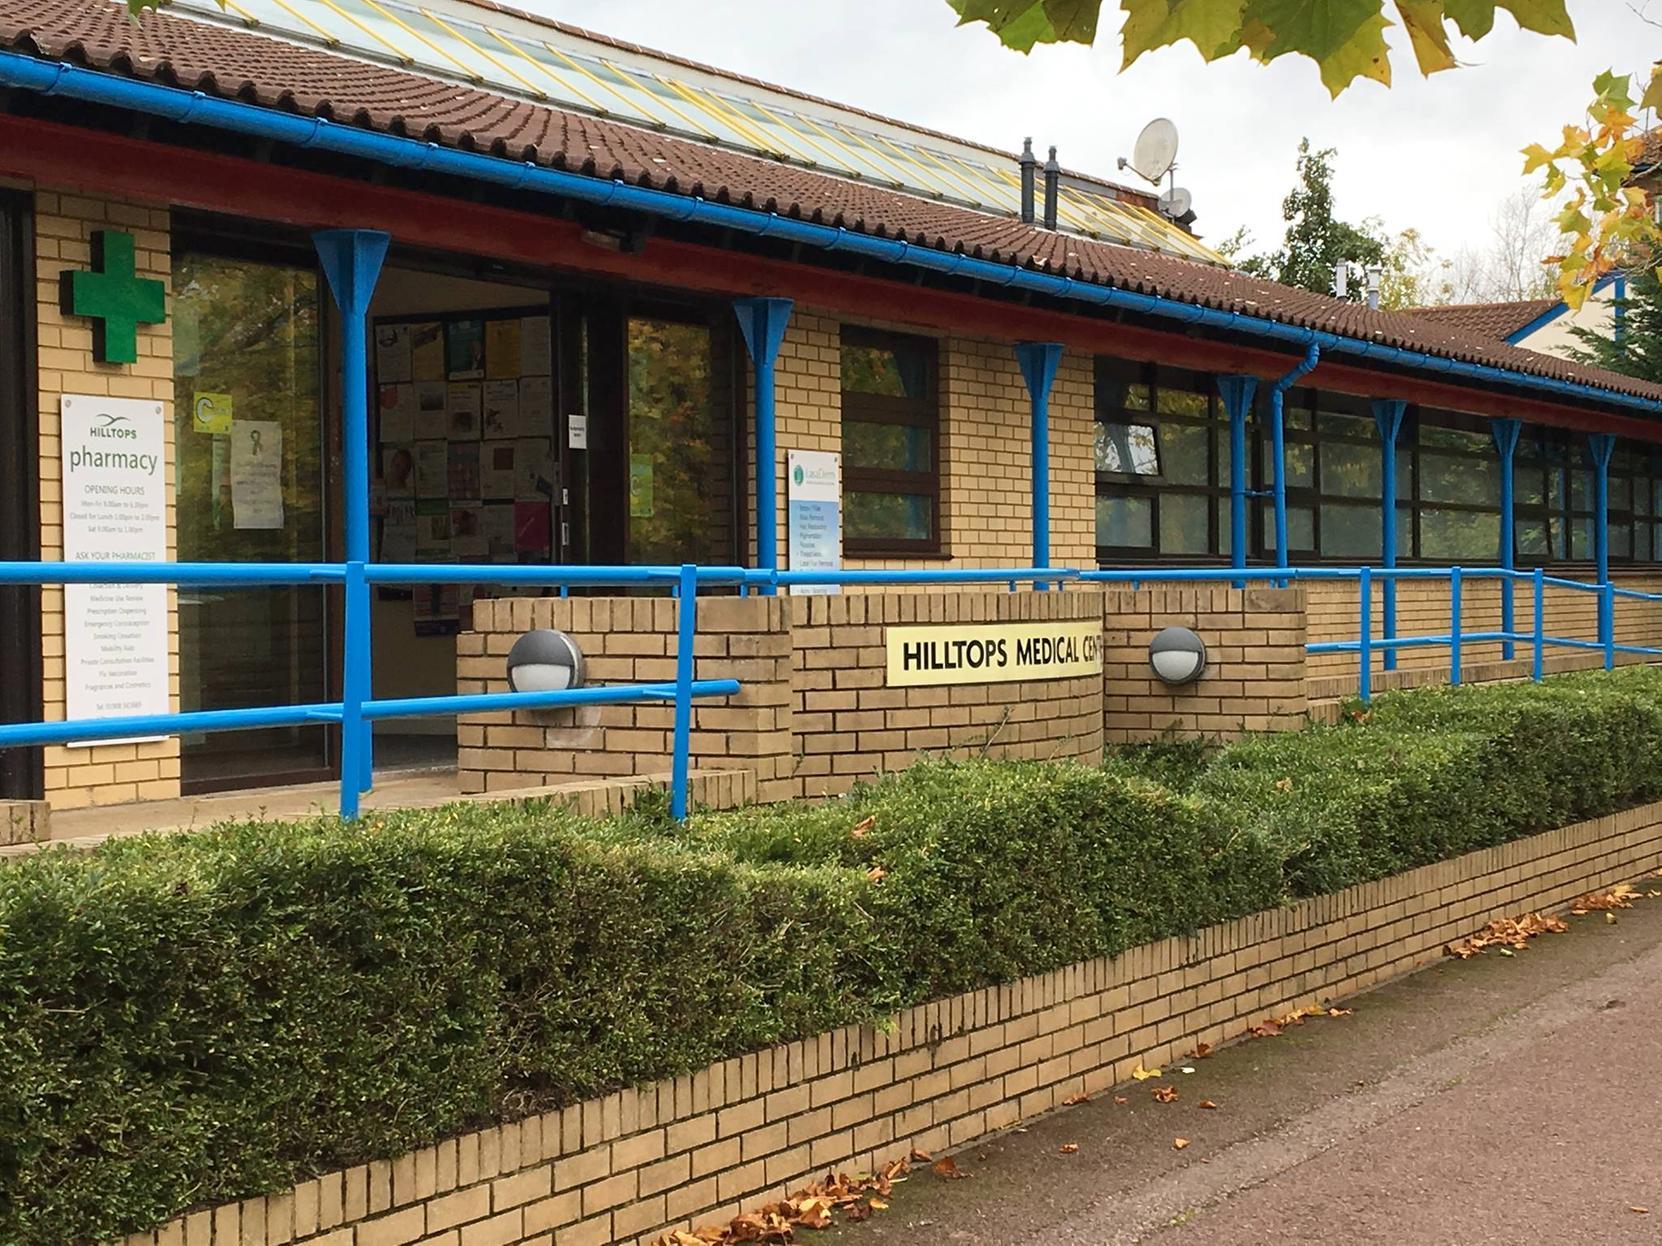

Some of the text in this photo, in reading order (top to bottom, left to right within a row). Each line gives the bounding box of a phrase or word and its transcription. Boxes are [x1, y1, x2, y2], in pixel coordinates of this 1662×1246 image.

[90, 427, 137, 439] HILLTOPS
[70, 445, 158, 476] pharmacy
[84, 484, 145, 495] OPENING HOURS
[75, 552, 156, 561] ASK YOUR PHARMACIST
[903, 639, 1008, 671] HILLTOPS
[1016, 635, 1080, 666] MEDICAL
